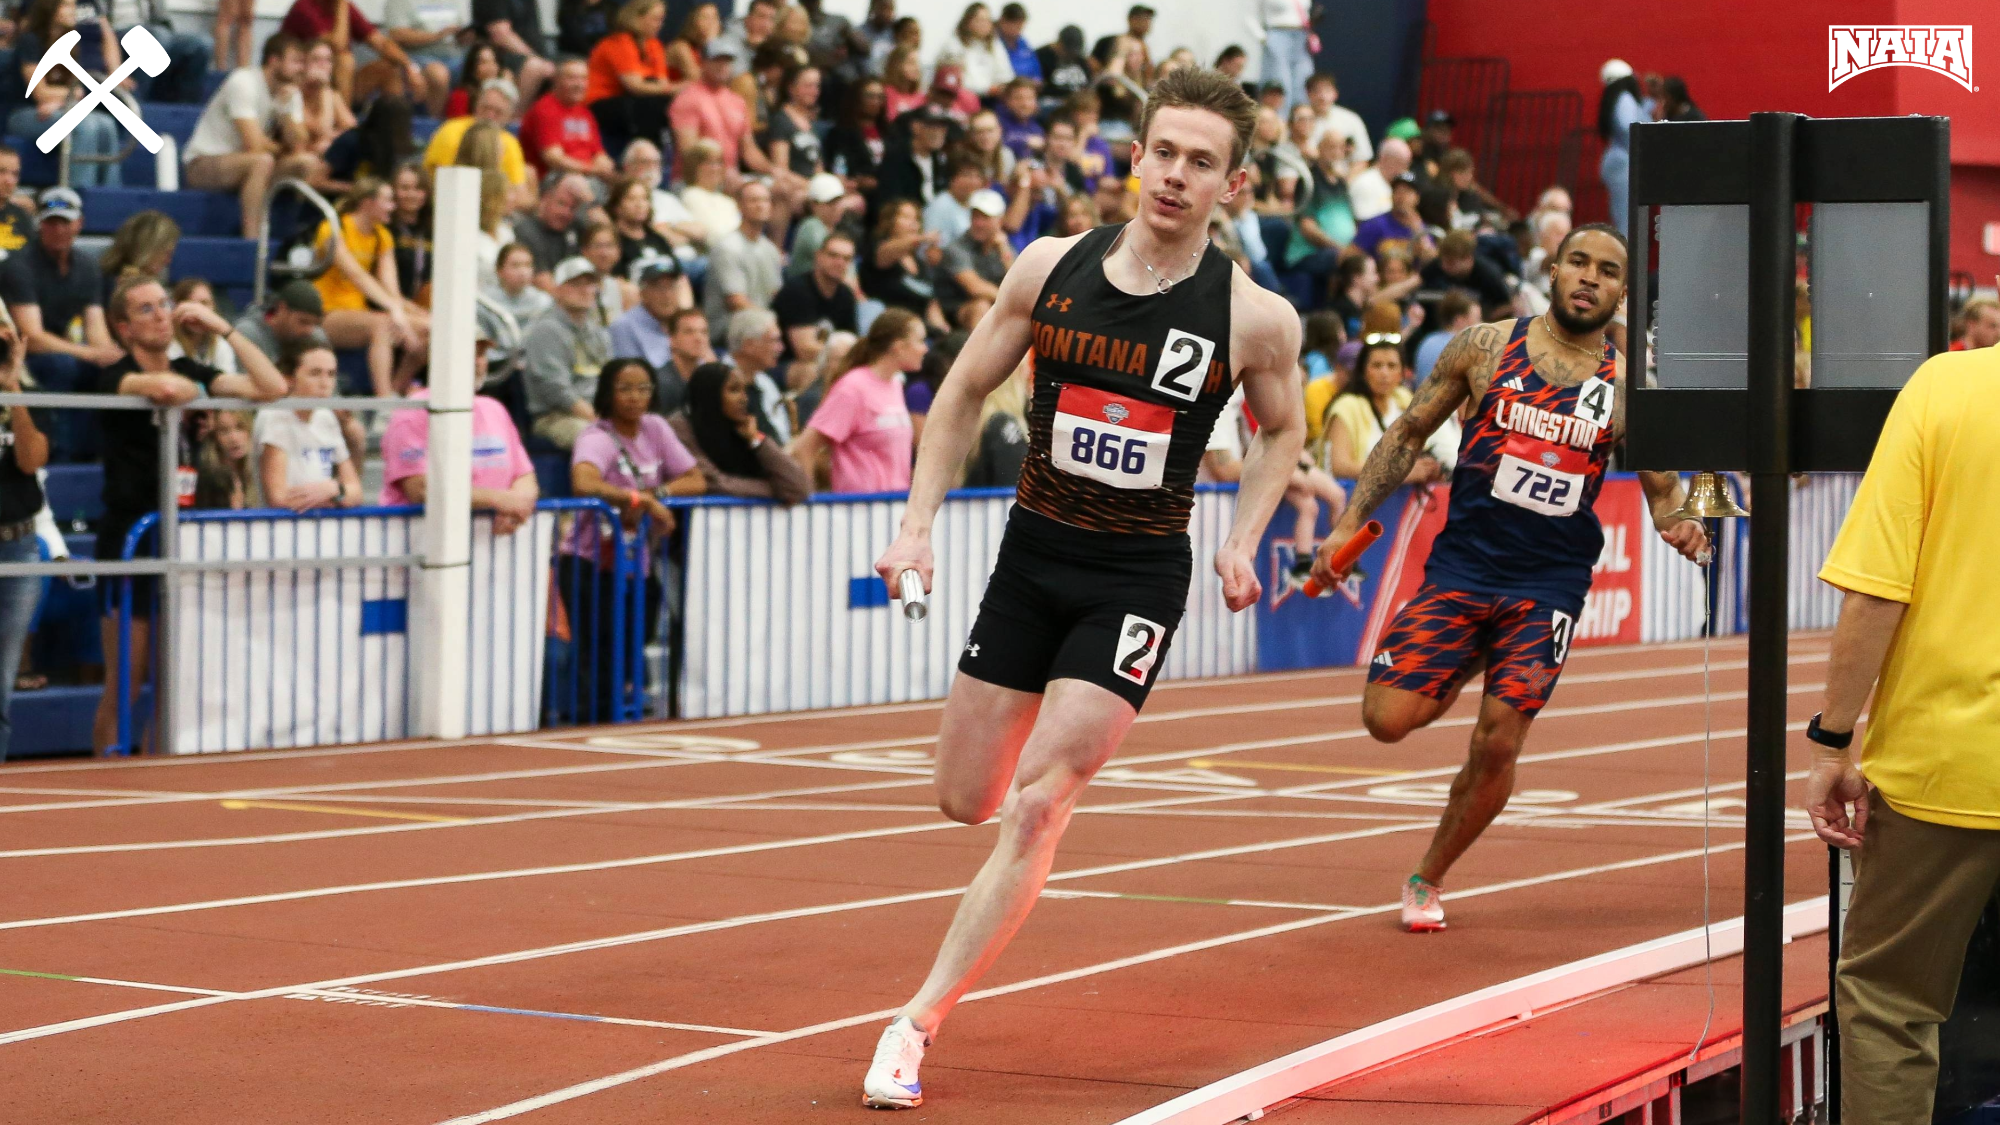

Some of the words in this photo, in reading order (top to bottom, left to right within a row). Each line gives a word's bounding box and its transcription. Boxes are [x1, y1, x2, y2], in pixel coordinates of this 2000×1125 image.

[1159, 337, 1203, 395] 2
[1495, 398, 1600, 451] LANGSTON
[1581, 382, 1608, 422] 4
[1071, 426, 1148, 475] 866
[1511, 466, 1571, 507] 722
[1118, 622, 1156, 680] 2
